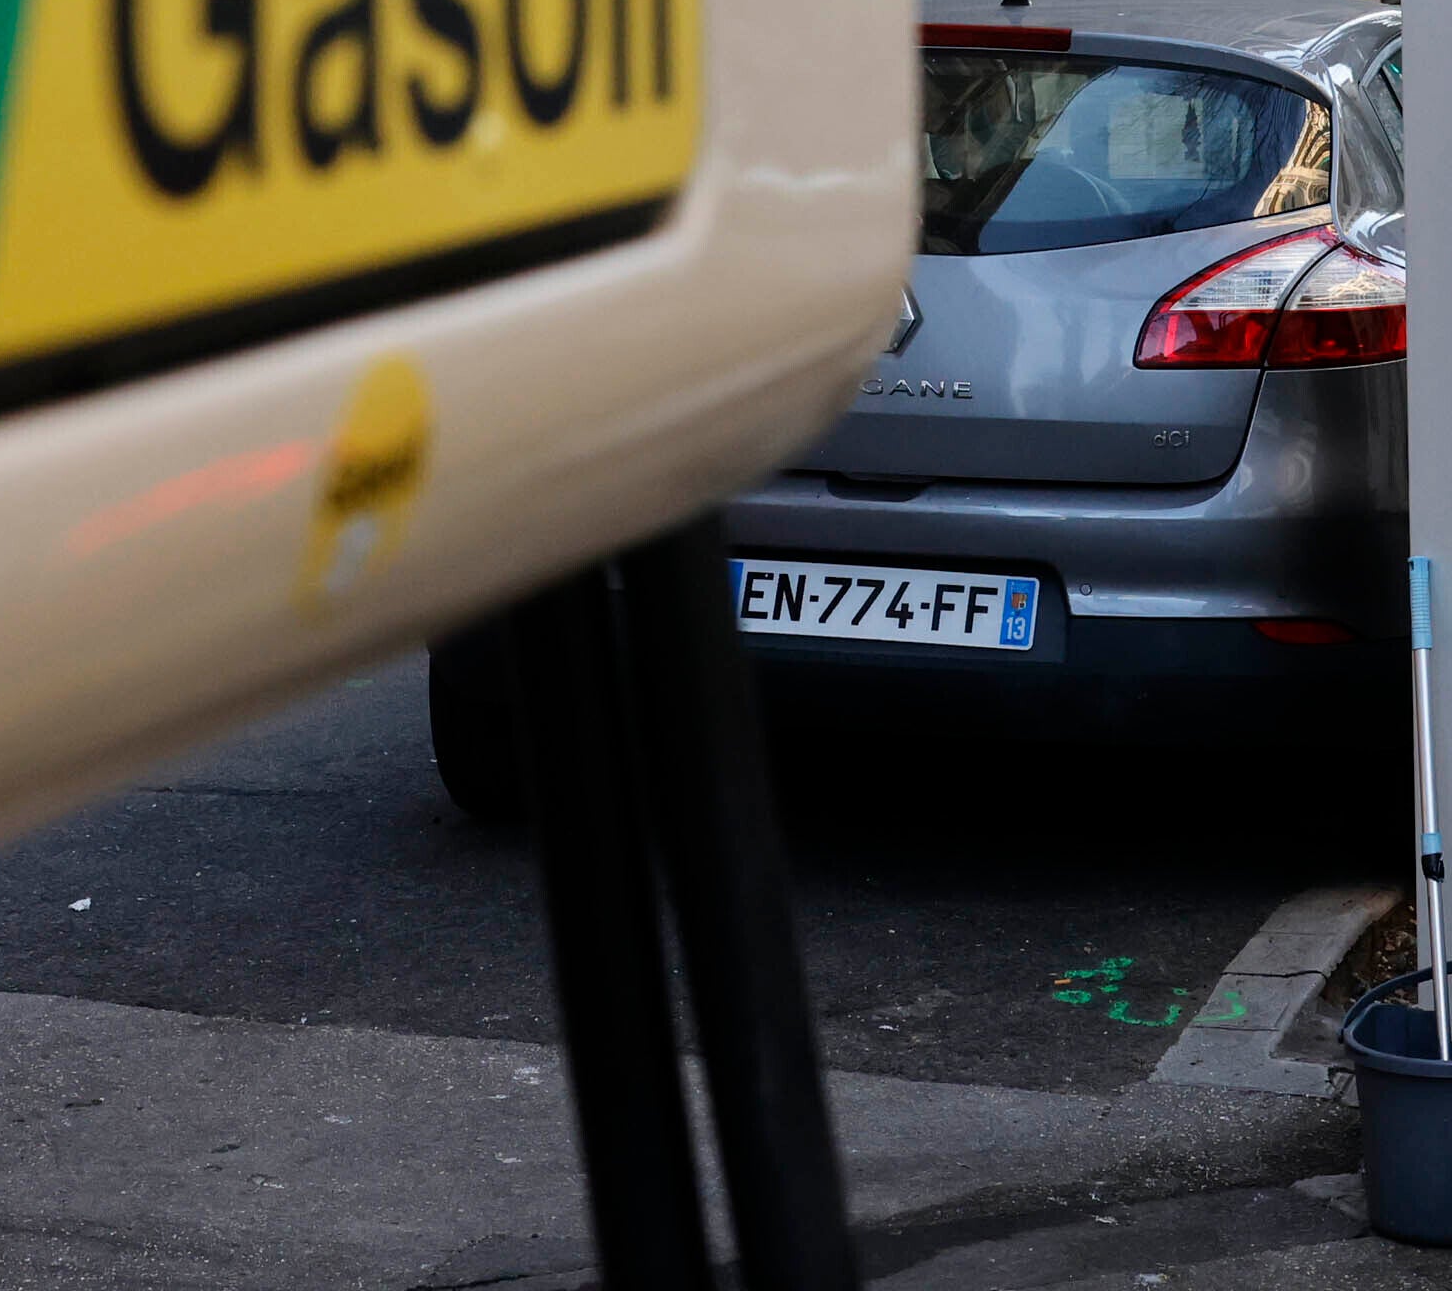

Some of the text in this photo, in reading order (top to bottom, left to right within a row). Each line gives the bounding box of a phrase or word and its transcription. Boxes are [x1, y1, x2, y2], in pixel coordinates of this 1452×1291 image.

[1153, 430, 1191, 448] dCi
[740, 570, 999, 634] EN-774-FF
[1004, 616, 1027, 642] 13
